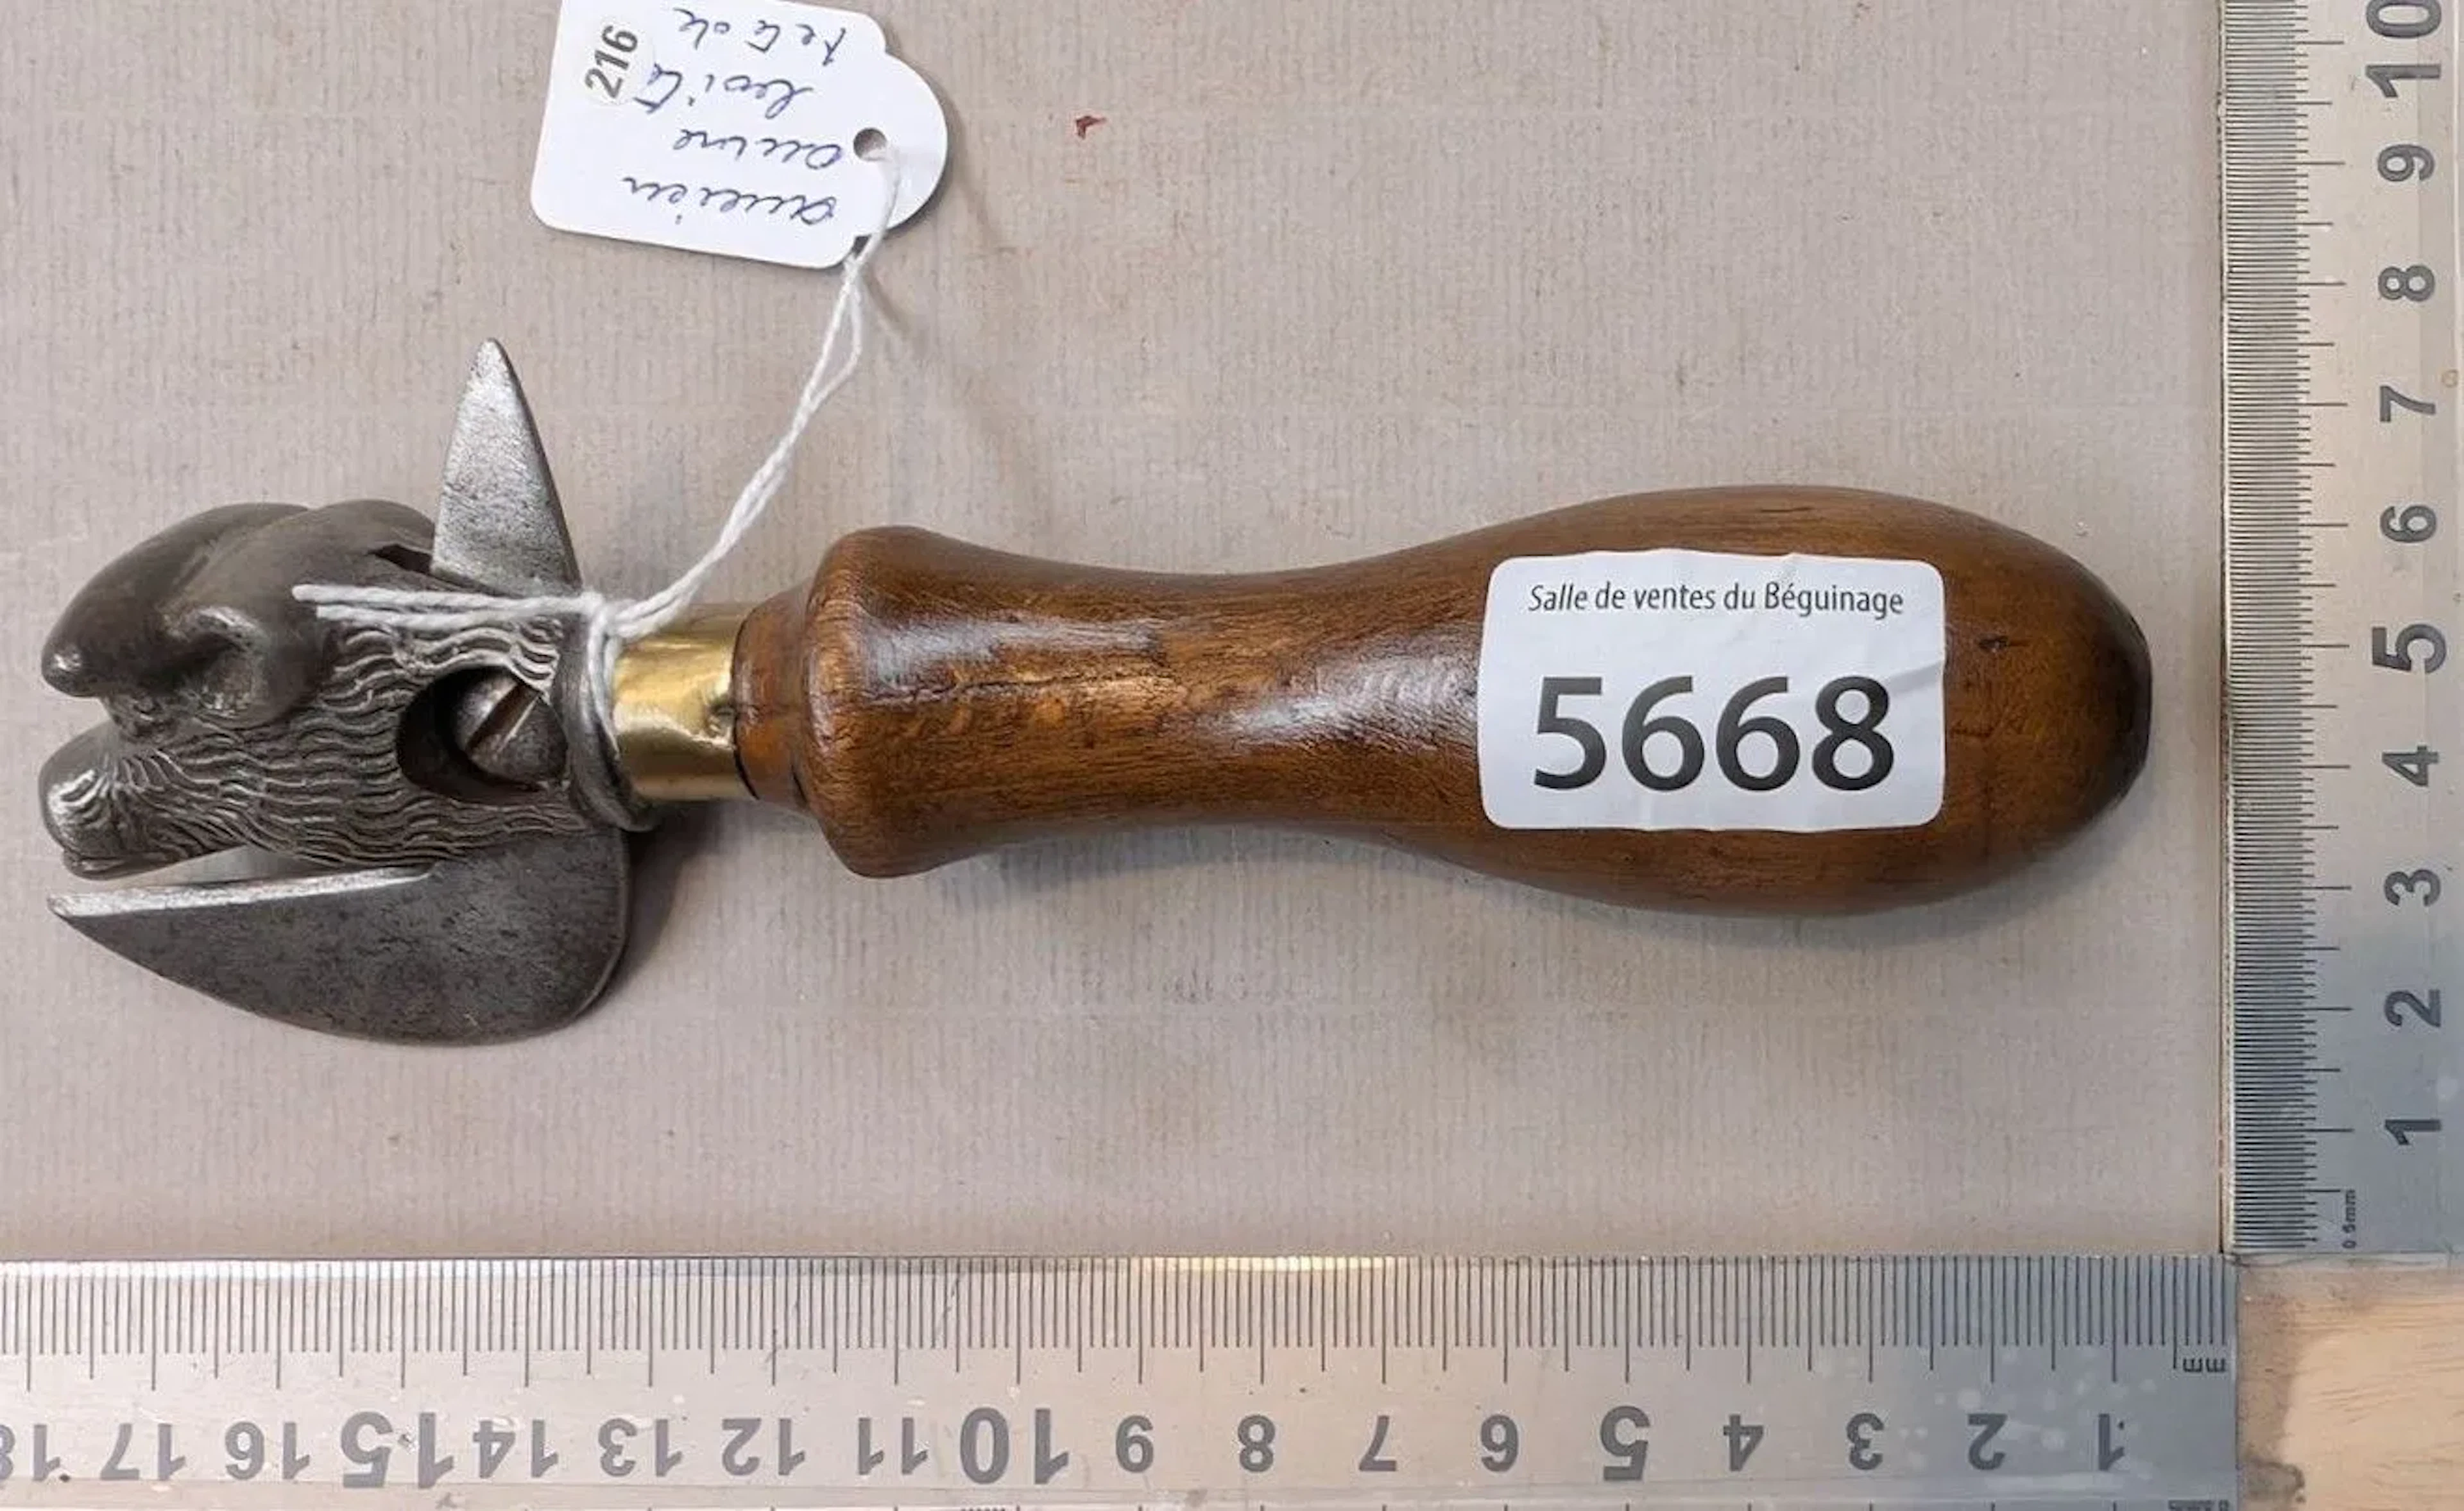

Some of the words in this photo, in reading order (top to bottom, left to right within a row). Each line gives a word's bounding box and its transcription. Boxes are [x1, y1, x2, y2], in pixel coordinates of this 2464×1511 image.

[585, 24, 638, 98] 216
[2366, 0, 2442, 98] 10
[2377, 144, 2435, 182] 9
[2378, 265, 2435, 302] 8
[2380, 386, 2436, 423] 7
[2380, 505, 2437, 543] 6
[1528, 584, 1589, 611] Salle
[1595, 583, 1627, 611] de
[1634, 586, 1717, 611] ventes
[1724, 585, 1756, 611] du
[1763, 583, 1904, 620] Béguinage
[2372, 624, 2447, 673] 5
[1534, 676, 1895, 792] 5668
[2381, 745, 2440, 787] 4
[2384, 869, 2441, 907] 3
[2384, 989, 2441, 1028] 2
[2384, 1119, 2442, 1145] 1
[2342, 1189, 2356, 1249] 05mm
[100, 1422, 186, 1481] 17
[224, 1421, 309, 1480] 16
[340, 1411, 454, 1489] 15
[472, 1419, 558, 1479] 14
[597, 1418, 682, 1477] 13
[722, 1418, 805, 1477] 12
[858, 1417, 928, 1476] 11
[959, 1406, 1068, 1485] 10
[1115, 1415, 1154, 1473] 9
[1237, 1415, 1276, 1473] 8
[1358, 1415, 1397, 1472] 7
[1480, 1415, 1519, 1473] 6
[1600, 1406, 1651, 1481] 5
[1723, 1415, 1764, 1472] 4
[1847, 1413, 1885, 1471] 3
[1968, 1413, 2008, 1471] 2
[2098, 1413, 2125, 1471] 1
